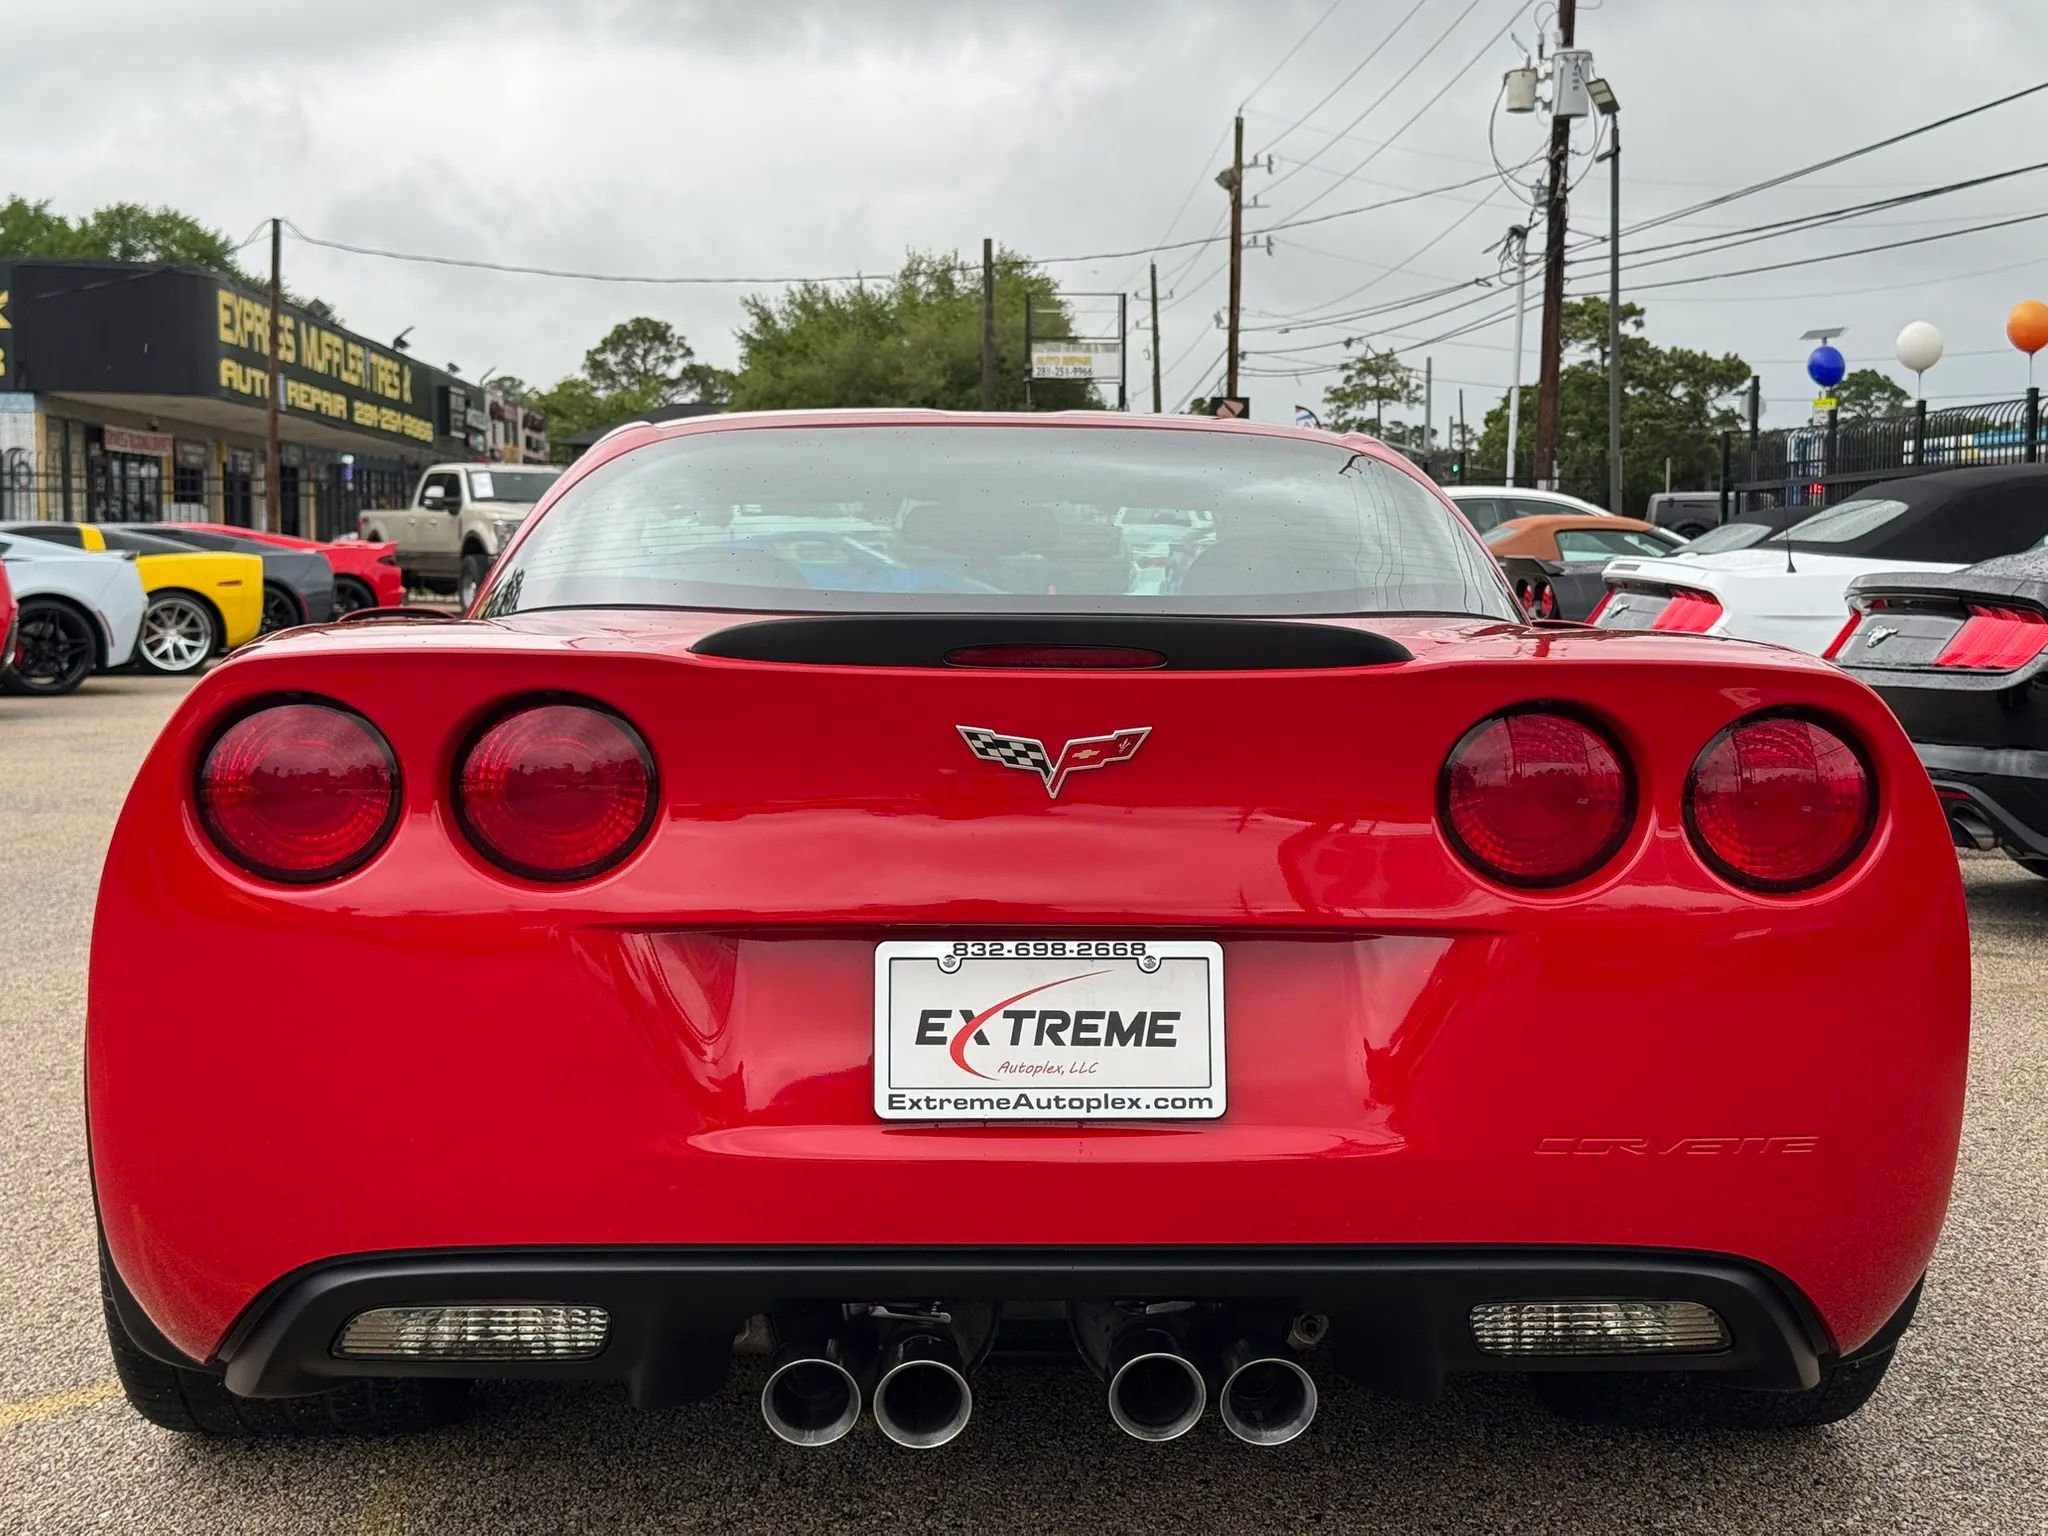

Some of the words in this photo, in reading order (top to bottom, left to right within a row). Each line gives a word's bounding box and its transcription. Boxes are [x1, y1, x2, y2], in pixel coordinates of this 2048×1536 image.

[300, 320, 366, 389] MUFFLER
[286, 378, 348, 420] REPAIR
[953, 942, 1147, 957] 832-698-2668
[914, 1008, 1182, 1048] EXTREME
[997, 1060, 1067, 1076] Autoplex,
[1068, 1060, 1099, 1075] LLC
[887, 1093, 1214, 1114] ExtremeAutoplex.com
[1533, 1136, 1820, 1155] CORVETTE
